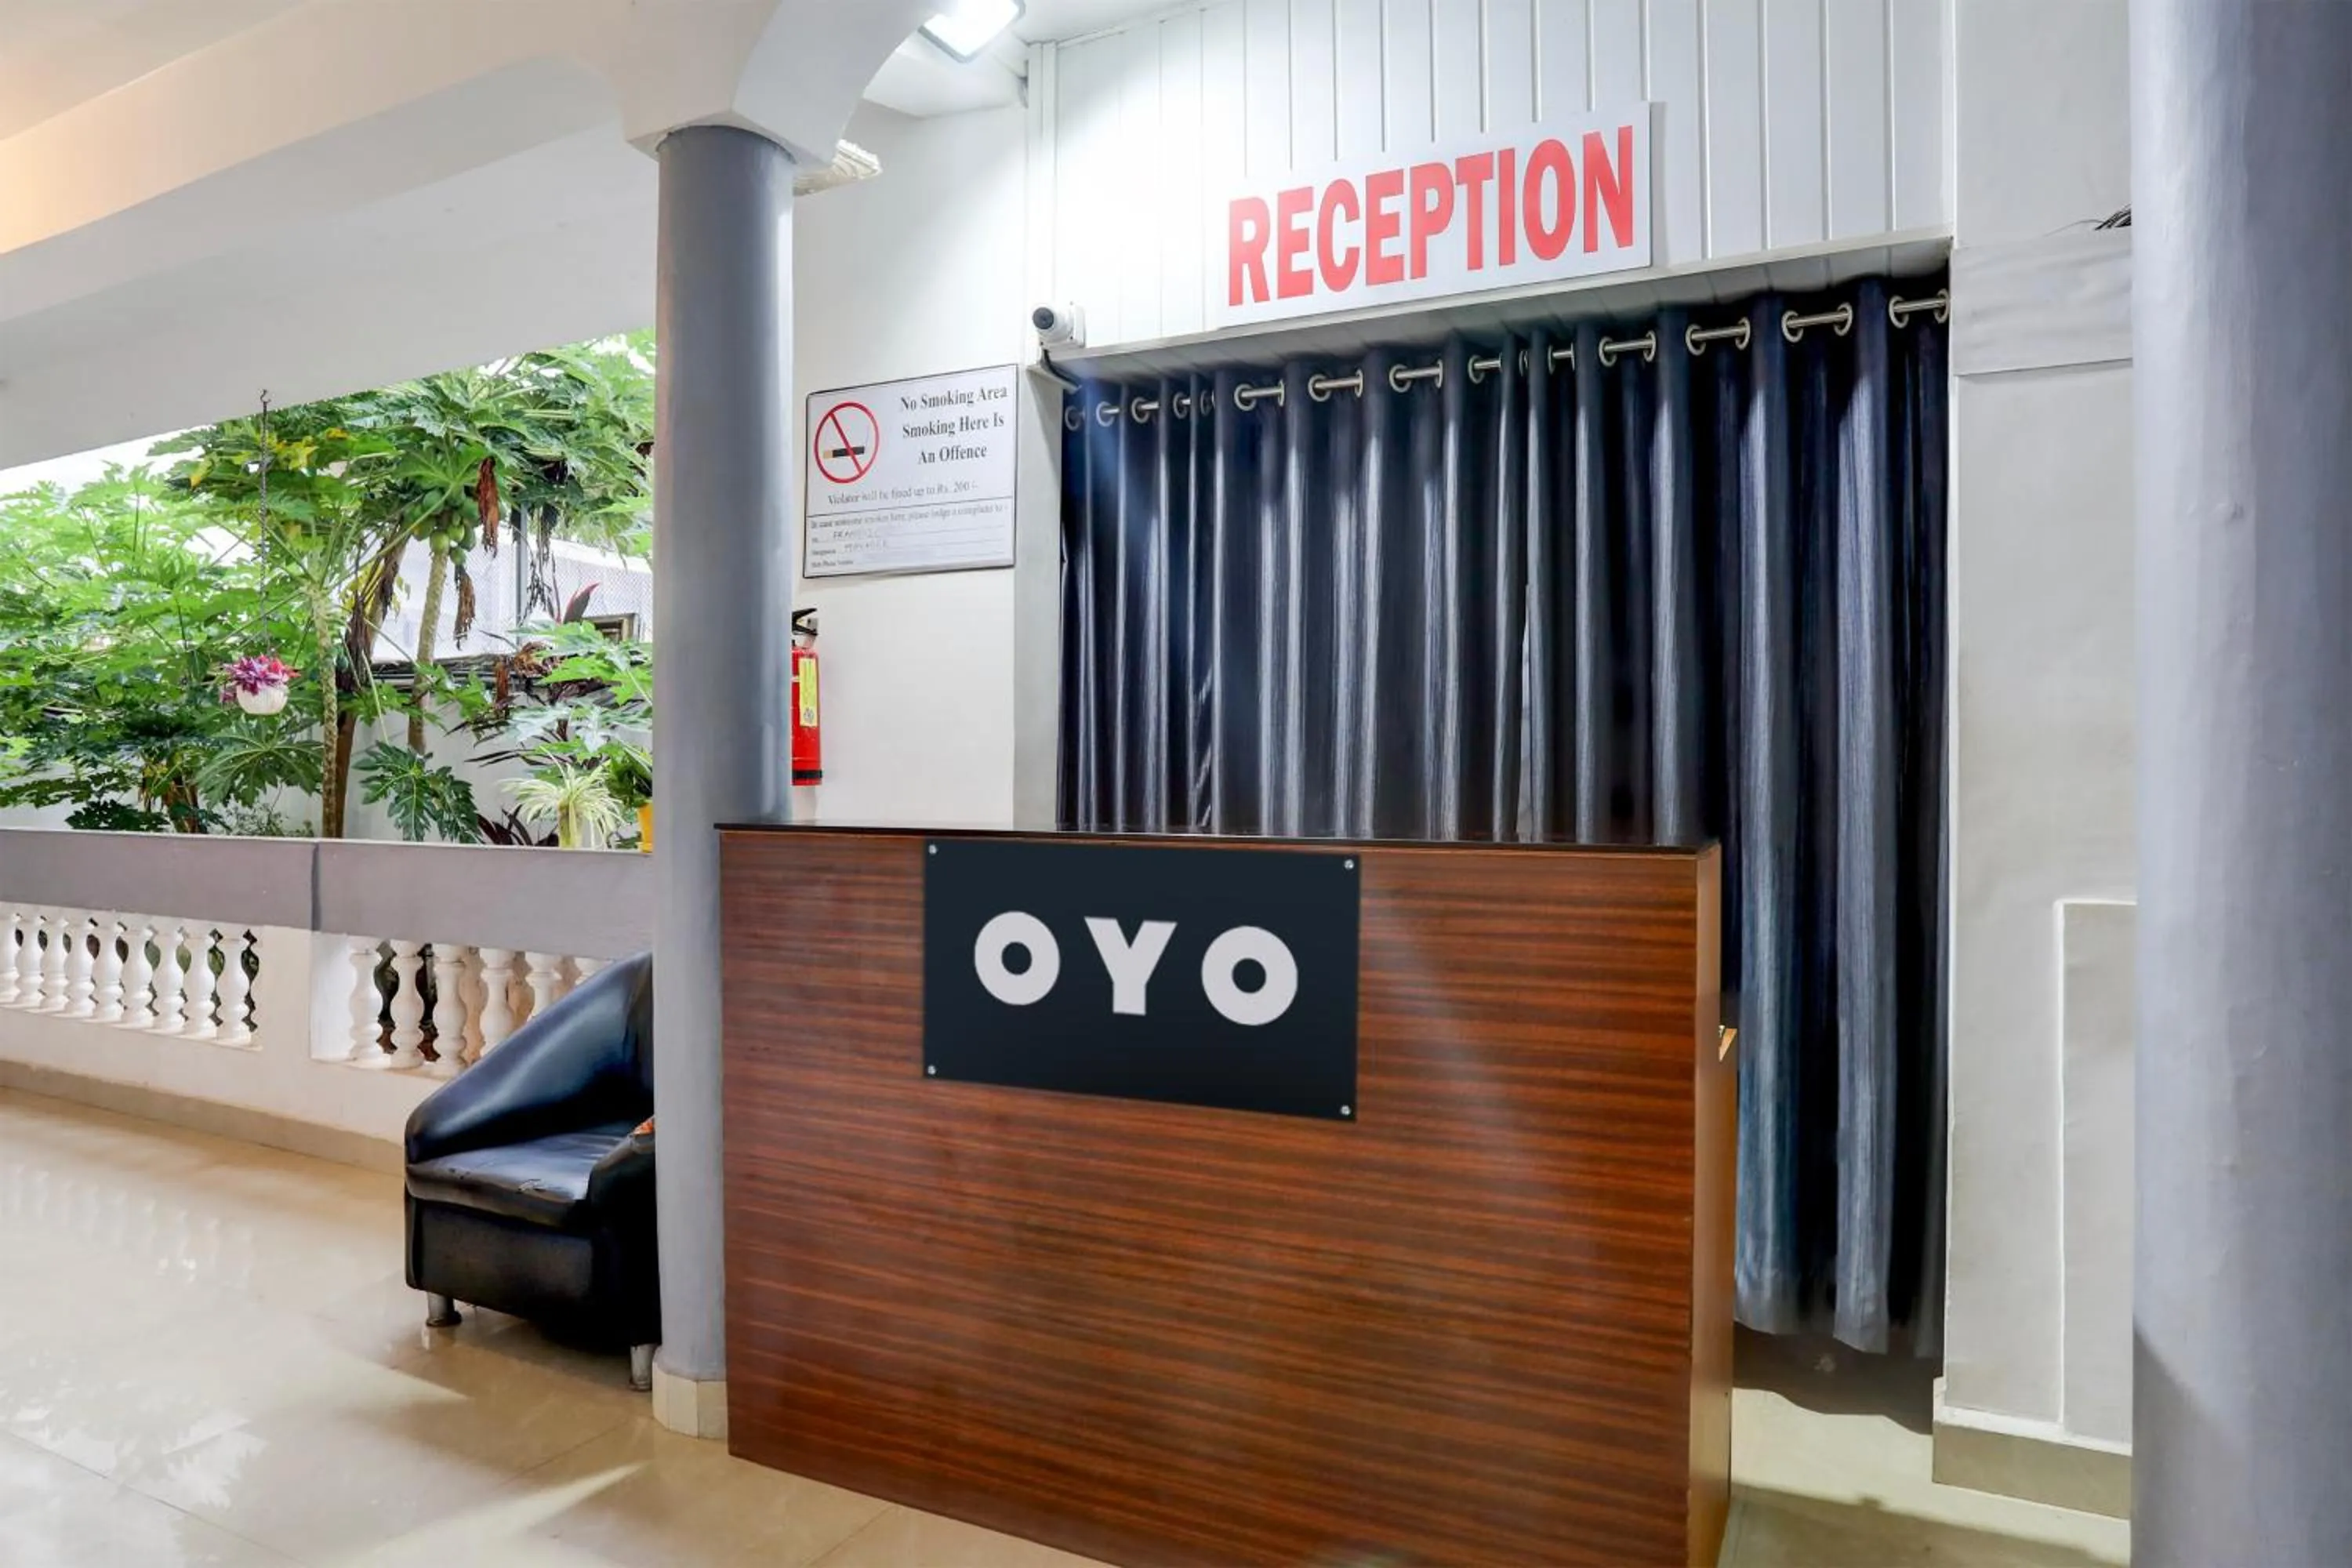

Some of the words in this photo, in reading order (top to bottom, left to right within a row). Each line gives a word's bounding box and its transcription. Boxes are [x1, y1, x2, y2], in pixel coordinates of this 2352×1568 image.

[1228, 125, 1634, 307] RECEPTION
[901, 397, 916, 411] No
[920, 390, 975, 408] Smoking
[978, 387, 1007, 401] Area
[902, 420, 955, 438] Smoking
[960, 416, 989, 432] Here
[993, 412, 1004, 426] Is
[918, 450, 935, 465] An
[939, 445, 987, 462] Offence
[862, 489, 877, 501] will
[879, 490, 889, 500] be
[891, 488, 912, 499] fined
[914, 487, 924, 497] up
[927, 486, 935, 495] to
[975, 911, 1298, 1025] OYO
